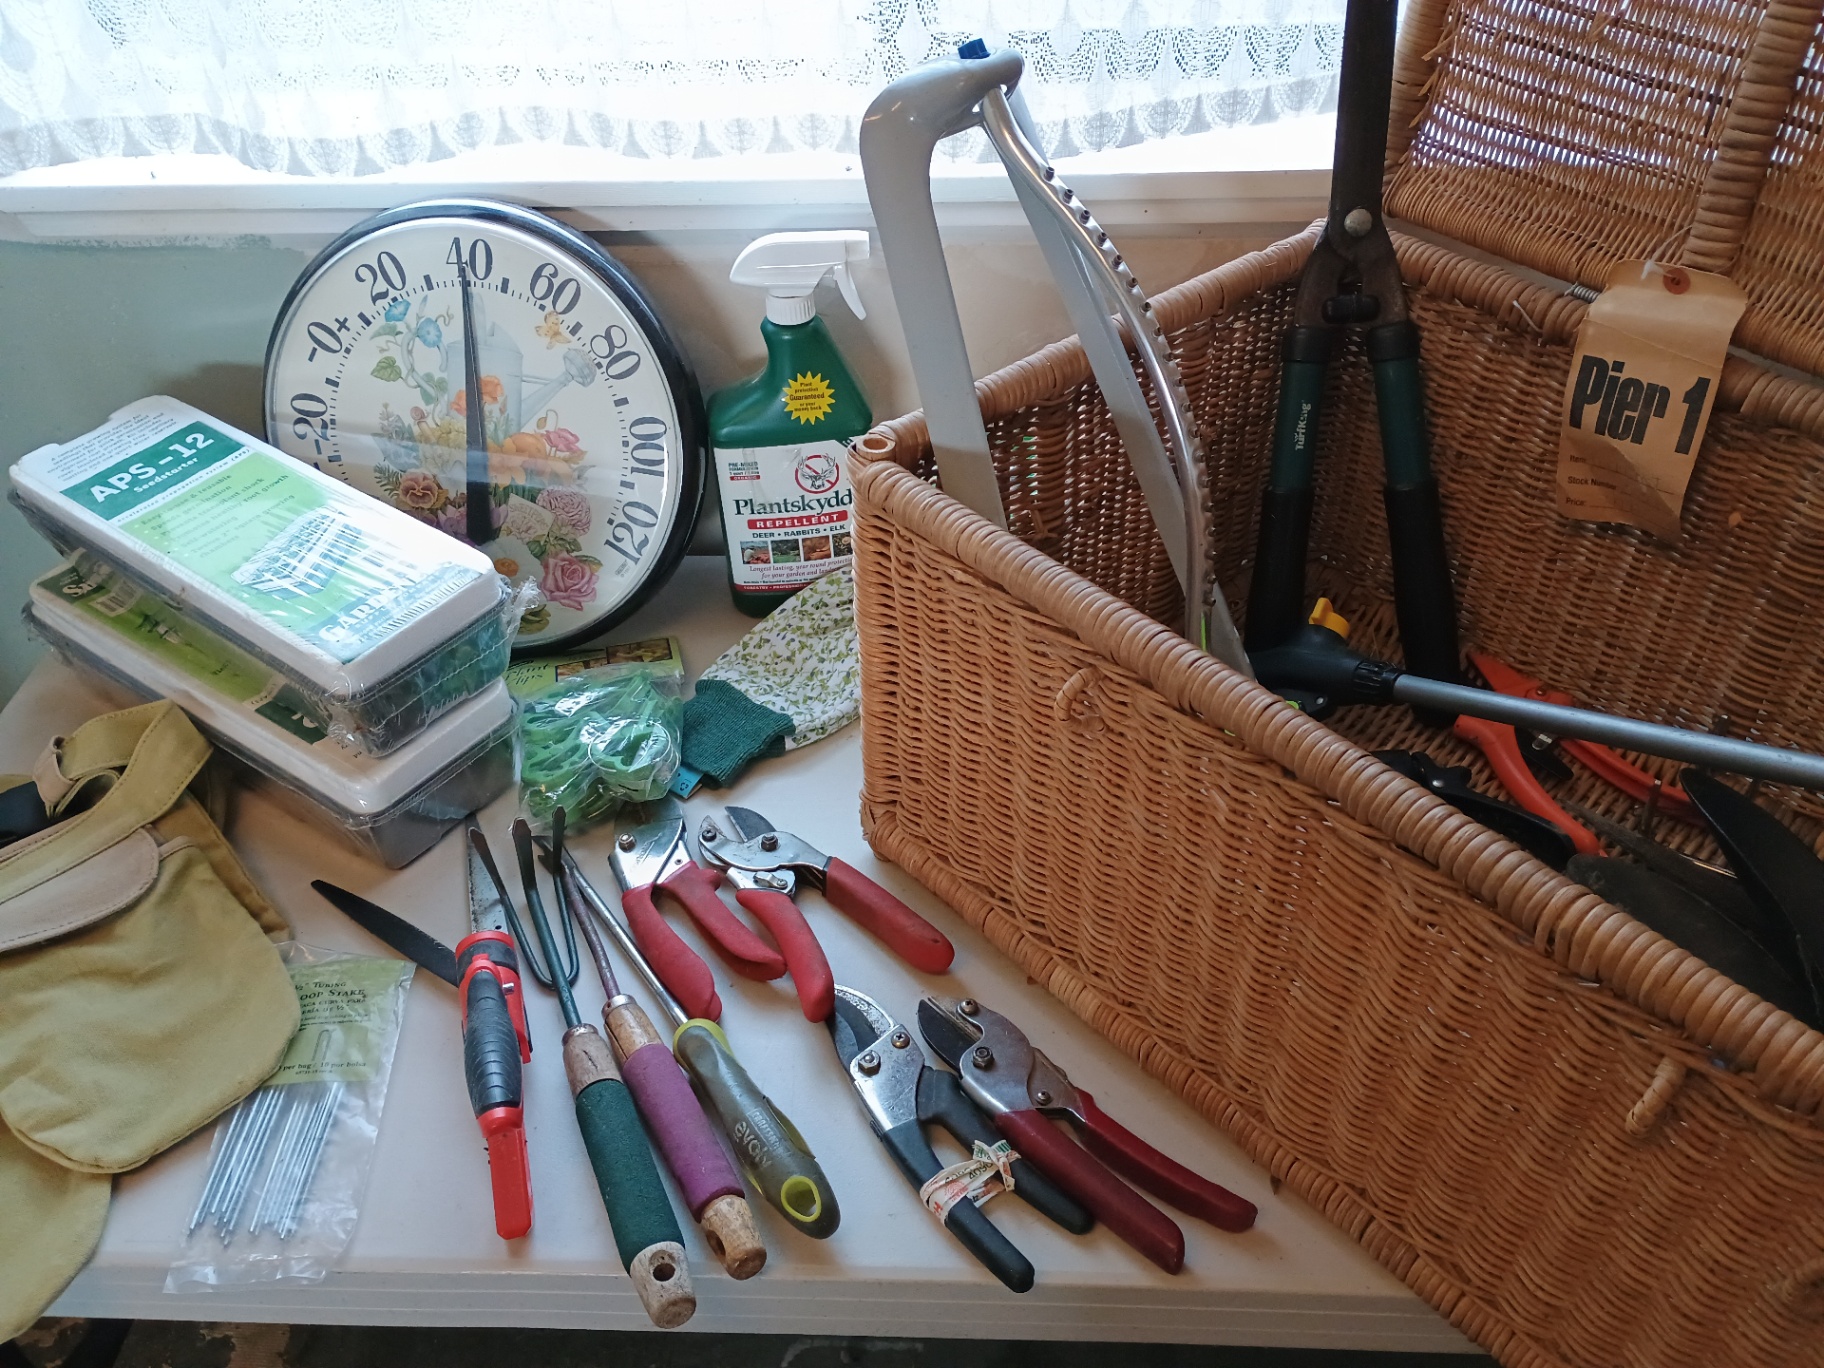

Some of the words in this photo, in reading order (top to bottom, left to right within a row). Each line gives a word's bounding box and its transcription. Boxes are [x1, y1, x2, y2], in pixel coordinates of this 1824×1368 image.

[355, 251, 407, 305] 20
[446, 237, 493, 280] 40
[530, 262, 581, 315] 60
[590, 324, 641, 381] 80
[1569, 355, 1670, 445] Pier
[1674, 377, 1711, 455] 1
[630, 416, 668, 480] 100
[134, 457, 198, 493] Seedstarter
[1568, 476, 1588, 486] Stock
[733, 489, 852, 515] Plantskydd
[756, 514, 839, 527] REPELLENT
[604, 501, 659, 564] 120
[784, 528, 821, 537] RABBITS
[830, 524, 846, 532] ELK
[786, 570, 806, 578] garden
[300, 992, 323, 1000] OOP
